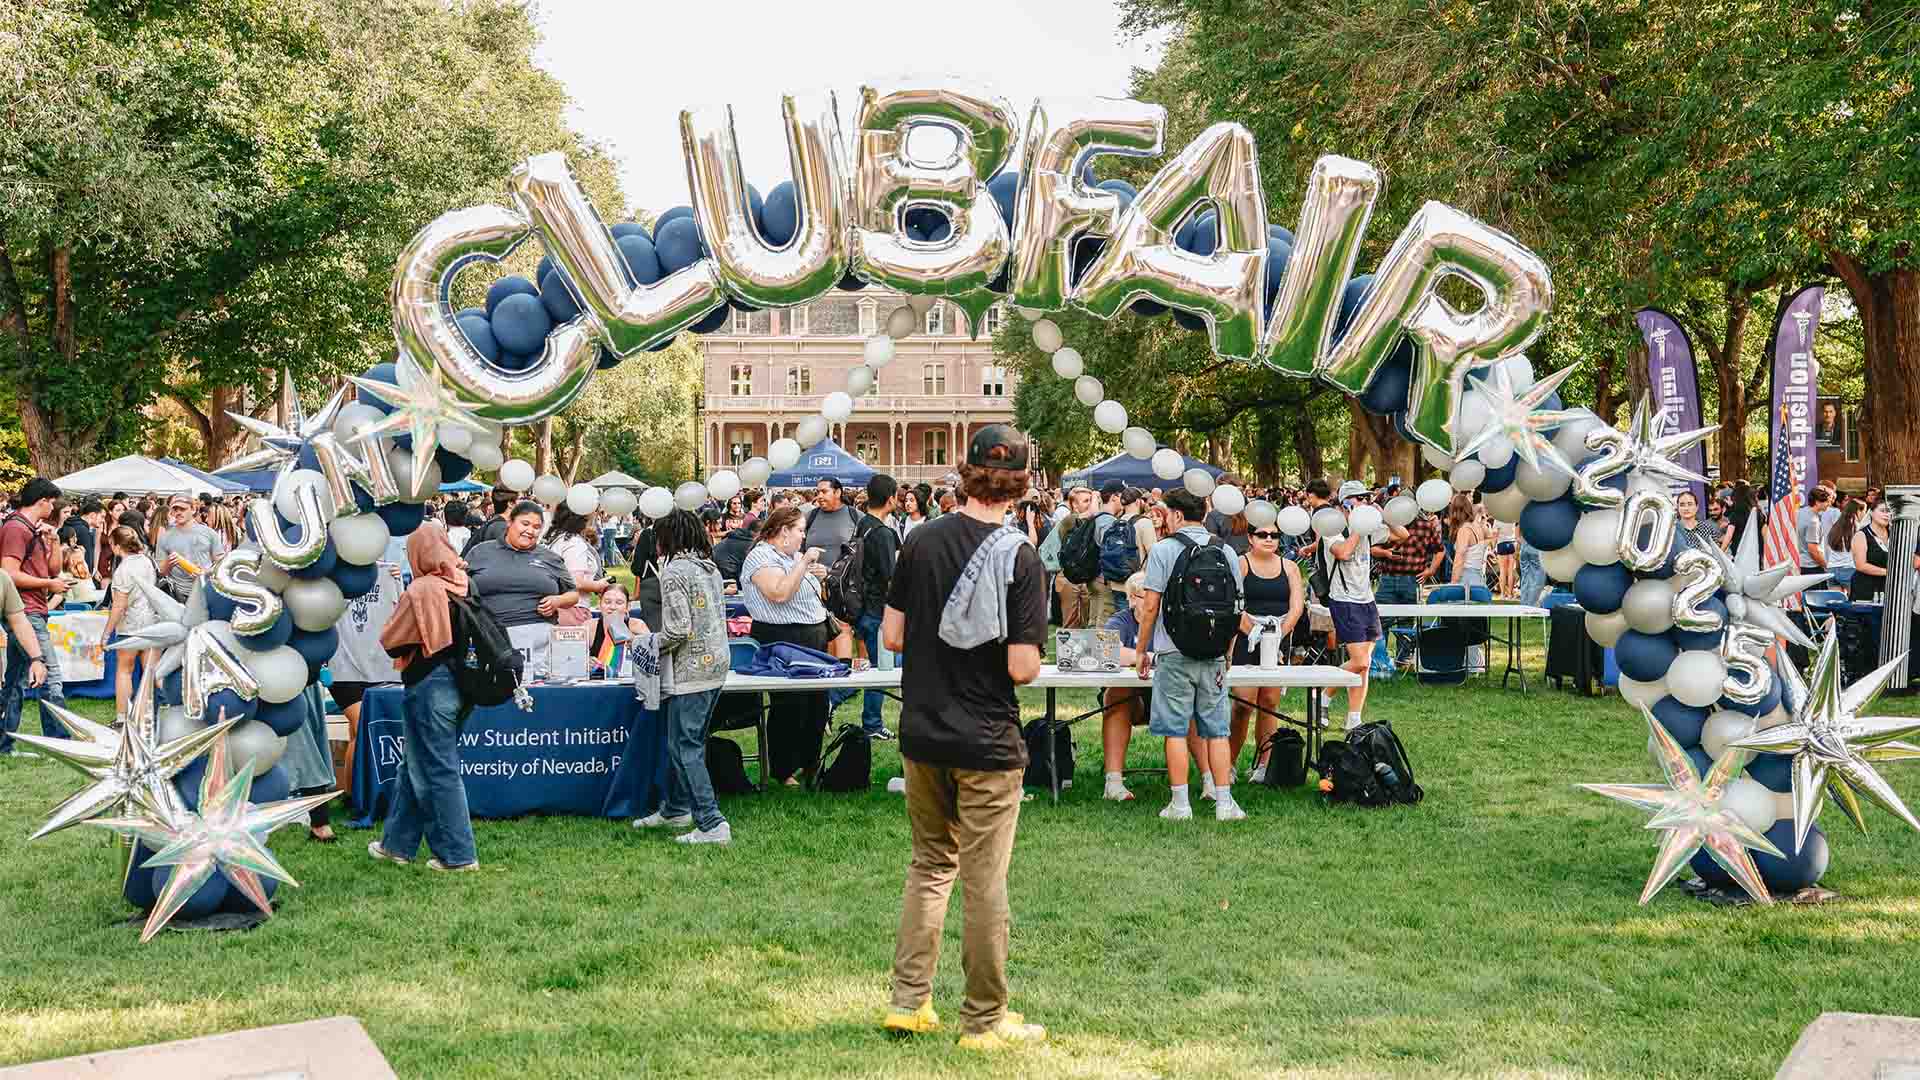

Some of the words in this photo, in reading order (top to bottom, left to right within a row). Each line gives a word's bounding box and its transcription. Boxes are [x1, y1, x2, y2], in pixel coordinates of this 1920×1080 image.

[390, 84, 1019, 424] CLUB
[1009, 96, 1554, 456] FAIR
[1785, 352, 1812, 448] Epsilon
[183, 431, 400, 720] ASUN
[1573, 430, 1777, 706] 2025
[460, 759, 518, 780] iversity
[521, 757, 540, 775] of
[542, 756, 609, 775] Nevada,
[484, 728, 560, 746] Student
